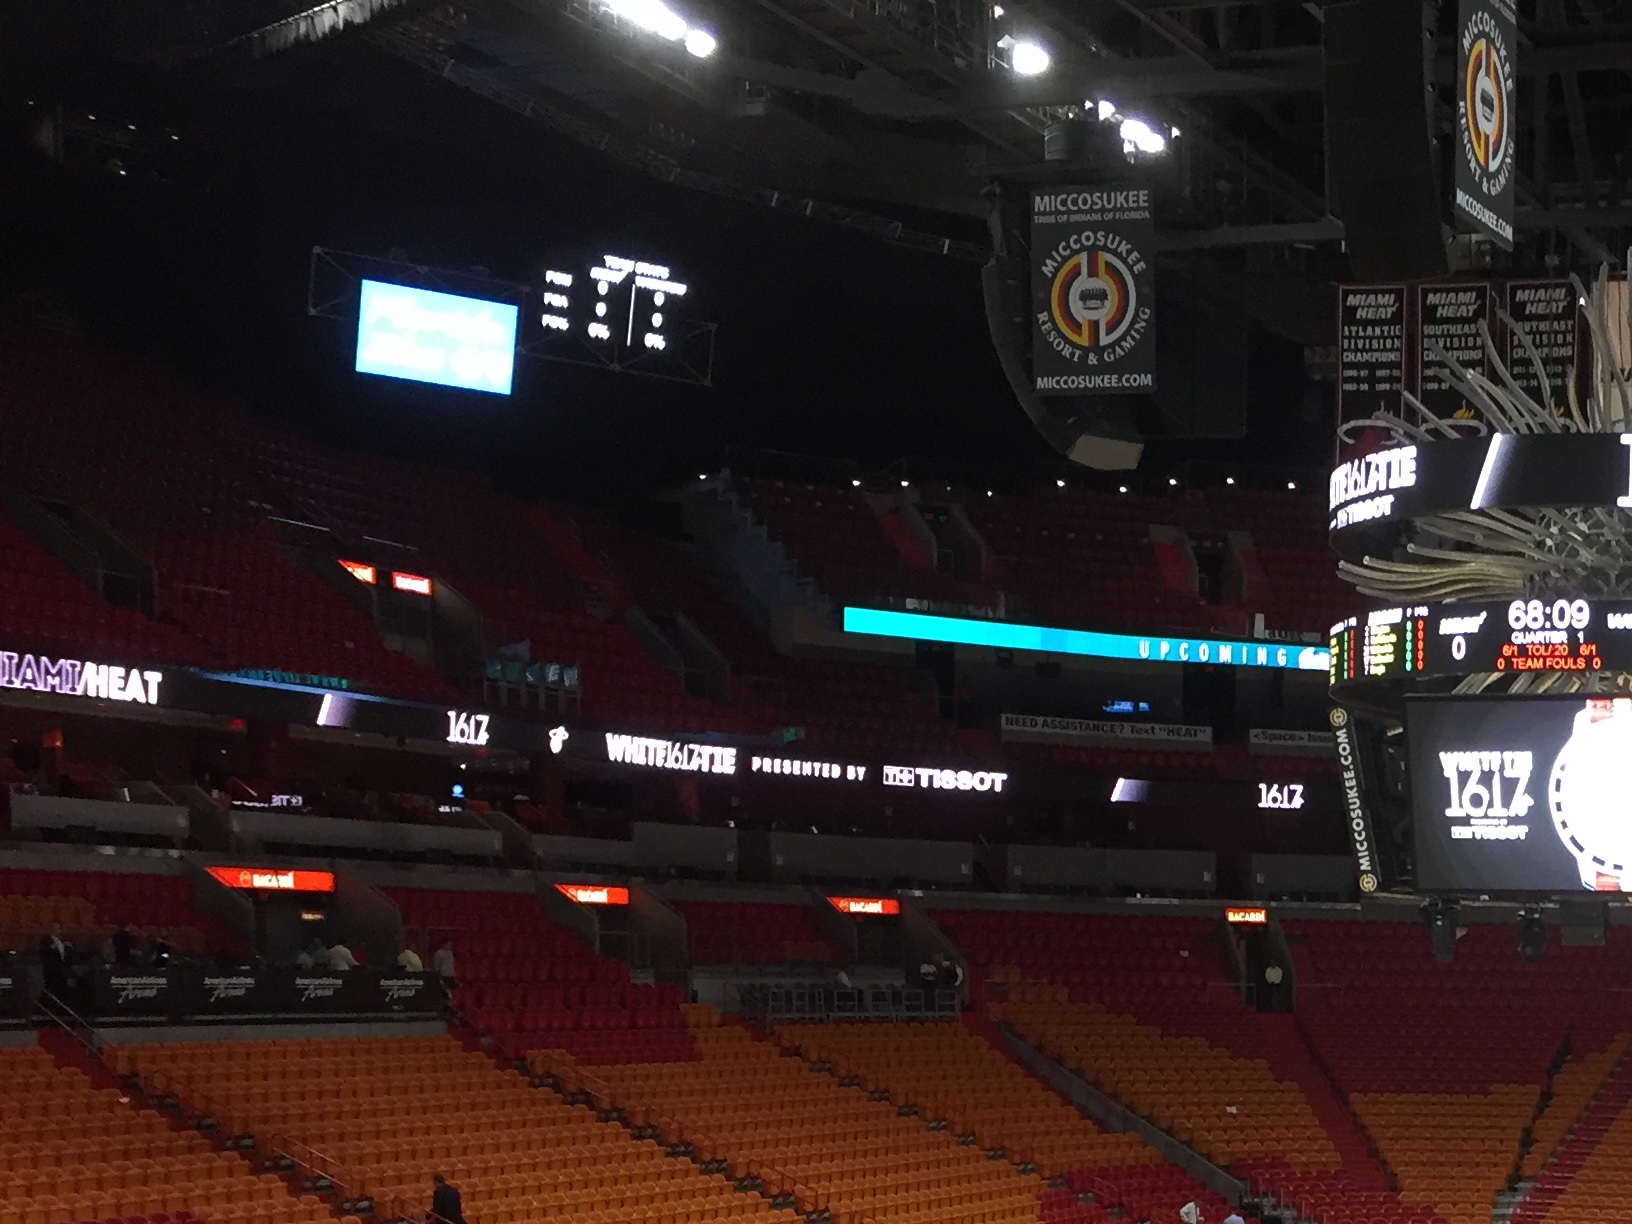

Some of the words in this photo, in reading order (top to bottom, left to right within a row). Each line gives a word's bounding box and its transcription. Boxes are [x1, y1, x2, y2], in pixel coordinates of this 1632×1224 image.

[1462, 11, 1513, 93] MICCOSUKEE
[1459, 100, 1480, 183] RESORT
[1034, 190, 1149, 213] MICCOSUKEE
[1456, 188, 1513, 242] MICCOSUKEE.COM
[1041, 231, 1147, 278] MICCOSUKEE
[1346, 293, 1396, 307] MIAMI
[1426, 291, 1477, 306] MIAMI
[1515, 288, 1566, 303] MIAMI
[1356, 303, 1399, 320] HEAT
[1436, 303, 1481, 318] HEAT
[1525, 301, 1570, 316] HEAT
[1037, 311, 1083, 363] RESORT
[1087, 352, 1098, 364] &
[1103, 307, 1150, 362] GAMING
[1343, 325, 1401, 336] ATLANTIC
[1343, 339, 1401, 349] DIVISION
[1343, 351, 1401, 362] CHAMPIONS
[1036, 374, 1152, 389] MICCOSUKEE.COM
[1508, 599, 1590, 629] 68:09
[1511, 631, 1568, 644] QUARTER
[1577, 631, 1584, 643] 1
[1139, 639, 1288, 668] UPCOMING
[1452, 635, 1466, 660] 0
[1579, 644, 1597, 656] 6/1
[1497, 658, 1505, 669] 0
[1512, 657, 1543, 669] TEAM
[1547, 657, 1586, 669] FOULS
[1592, 658, 1601, 669] 0
[447, 711, 489, 745] 1617
[1005, 716, 1038, 729] NEED
[1042, 718, 1125, 734] ASSISTANCE?
[751, 756, 841, 780] PRESENTED
[847, 765, 866, 781] BY
[915, 768, 1008, 792] TISSOT
[1257, 783, 1304, 808] 1617
[1336, 728, 1371, 871] MICCOSUKEE.COM
